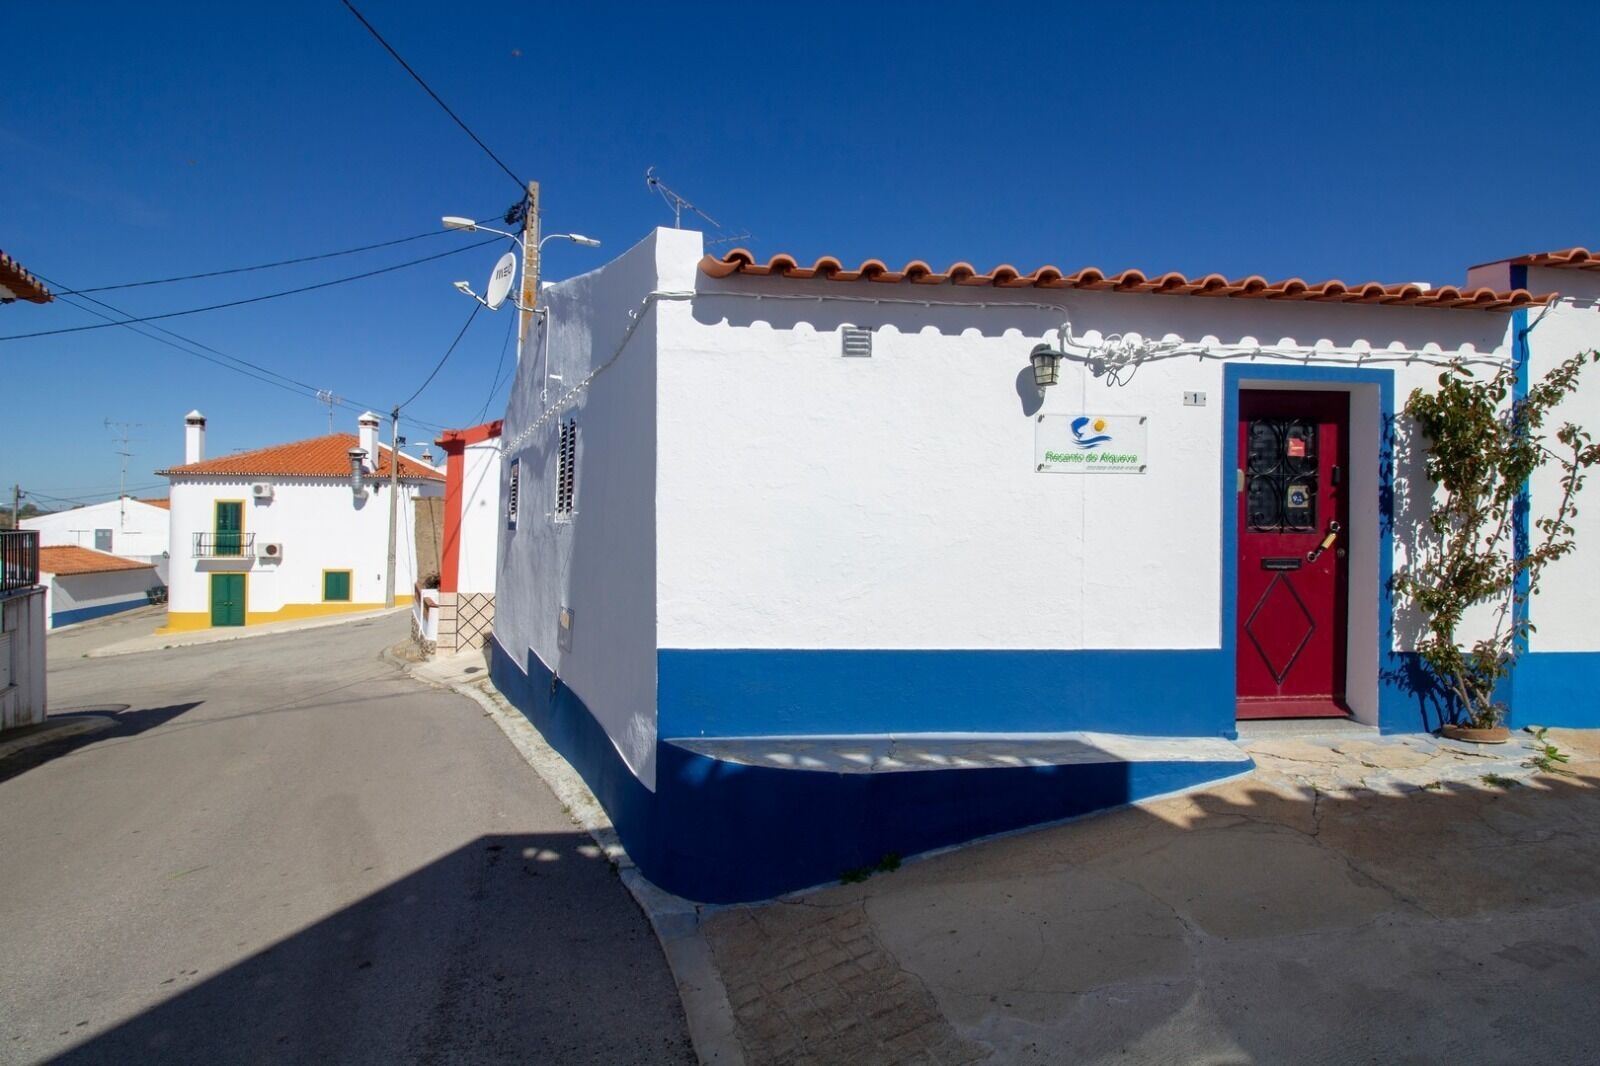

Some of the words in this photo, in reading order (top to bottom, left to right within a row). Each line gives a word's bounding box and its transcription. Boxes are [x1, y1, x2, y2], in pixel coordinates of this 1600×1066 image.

[1192, 393, 1198, 404] 1
[1045, 451, 1085, 463] Recanto
[1099, 451, 1138, 465] Alqueva
